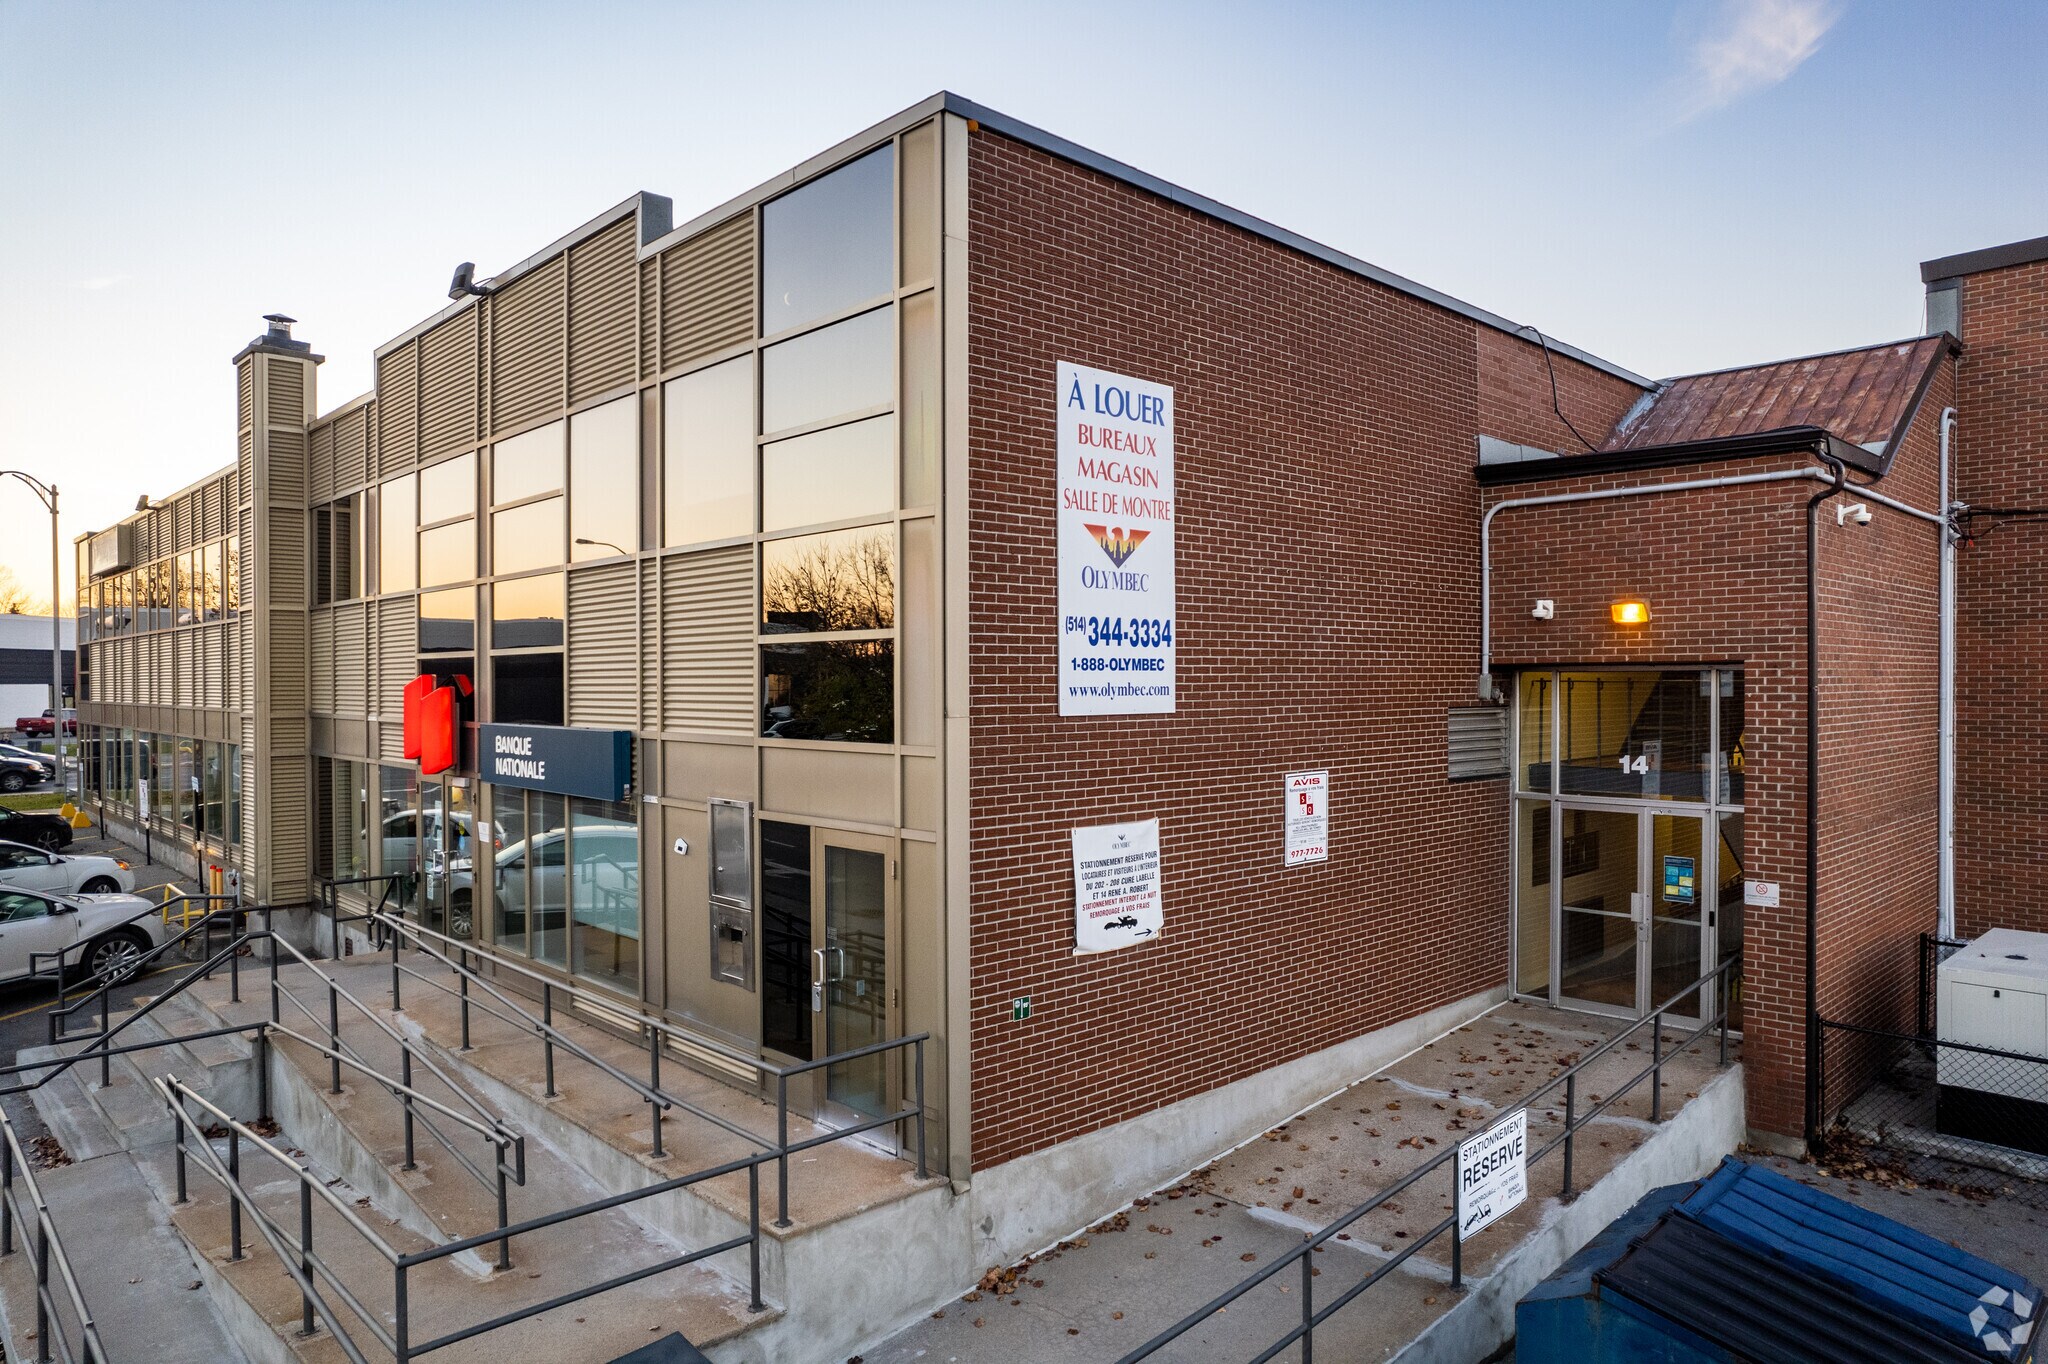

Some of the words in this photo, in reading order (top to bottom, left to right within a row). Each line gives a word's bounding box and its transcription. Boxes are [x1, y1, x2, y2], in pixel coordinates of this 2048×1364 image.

[1067, 372, 1086, 411] À
[1094, 383, 1166, 427] LOUER
[1077, 423, 1157, 458] BUREAUX
[1077, 456, 1159, 489] MAGASIN
[1063, 487, 1098, 512] SALLE
[1102, 491, 1118, 515] DE
[1121, 495, 1171, 520] MONTRE
[1081, 565, 1150, 593] OLYMBEC
[1065, 614, 1087, 636] (514)
[1088, 616, 1172, 647] 344-3334
[1071, 657, 1165, 671] 1-888-OLYMBEC
[1069, 682, 1170, 700] www.olymbec.com
[495, 735, 532, 756] BANQUE
[495, 757, 546, 780] NATIONALE
[1618, 754, 1649, 775] 14
[1293, 778, 1320, 786] AVIS
[1080, 856, 1124, 870] STATIONNEMENT
[1145, 851, 1158, 861] POUR
[1291, 847, 1323, 858] 977-7726
[1086, 882, 1094, 890] DU
[1094, 880, 1105, 889] 202
[1136, 872, 1155, 883] LABELLE
[1108, 868, 1114, 877] ET
[1114, 866, 1134, 877] VISITEURS
[1092, 892, 1098, 900] ET
[1101, 890, 1107, 898] 14
[1129, 884, 1149, 894] ROBERT
[1082, 899, 1118, 911] STATIONNEMENT
[1118, 895, 1138, 905] INTERDIT
[1090, 907, 1120, 919] REMORQUAGE
[1126, 903, 1135, 912] VOS
[1136, 902, 1150, 910] FRAIS
[1463, 1116, 1523, 1162] STATIONNEMENT
[1463, 1130, 1523, 1192] RÉSERVÉ
